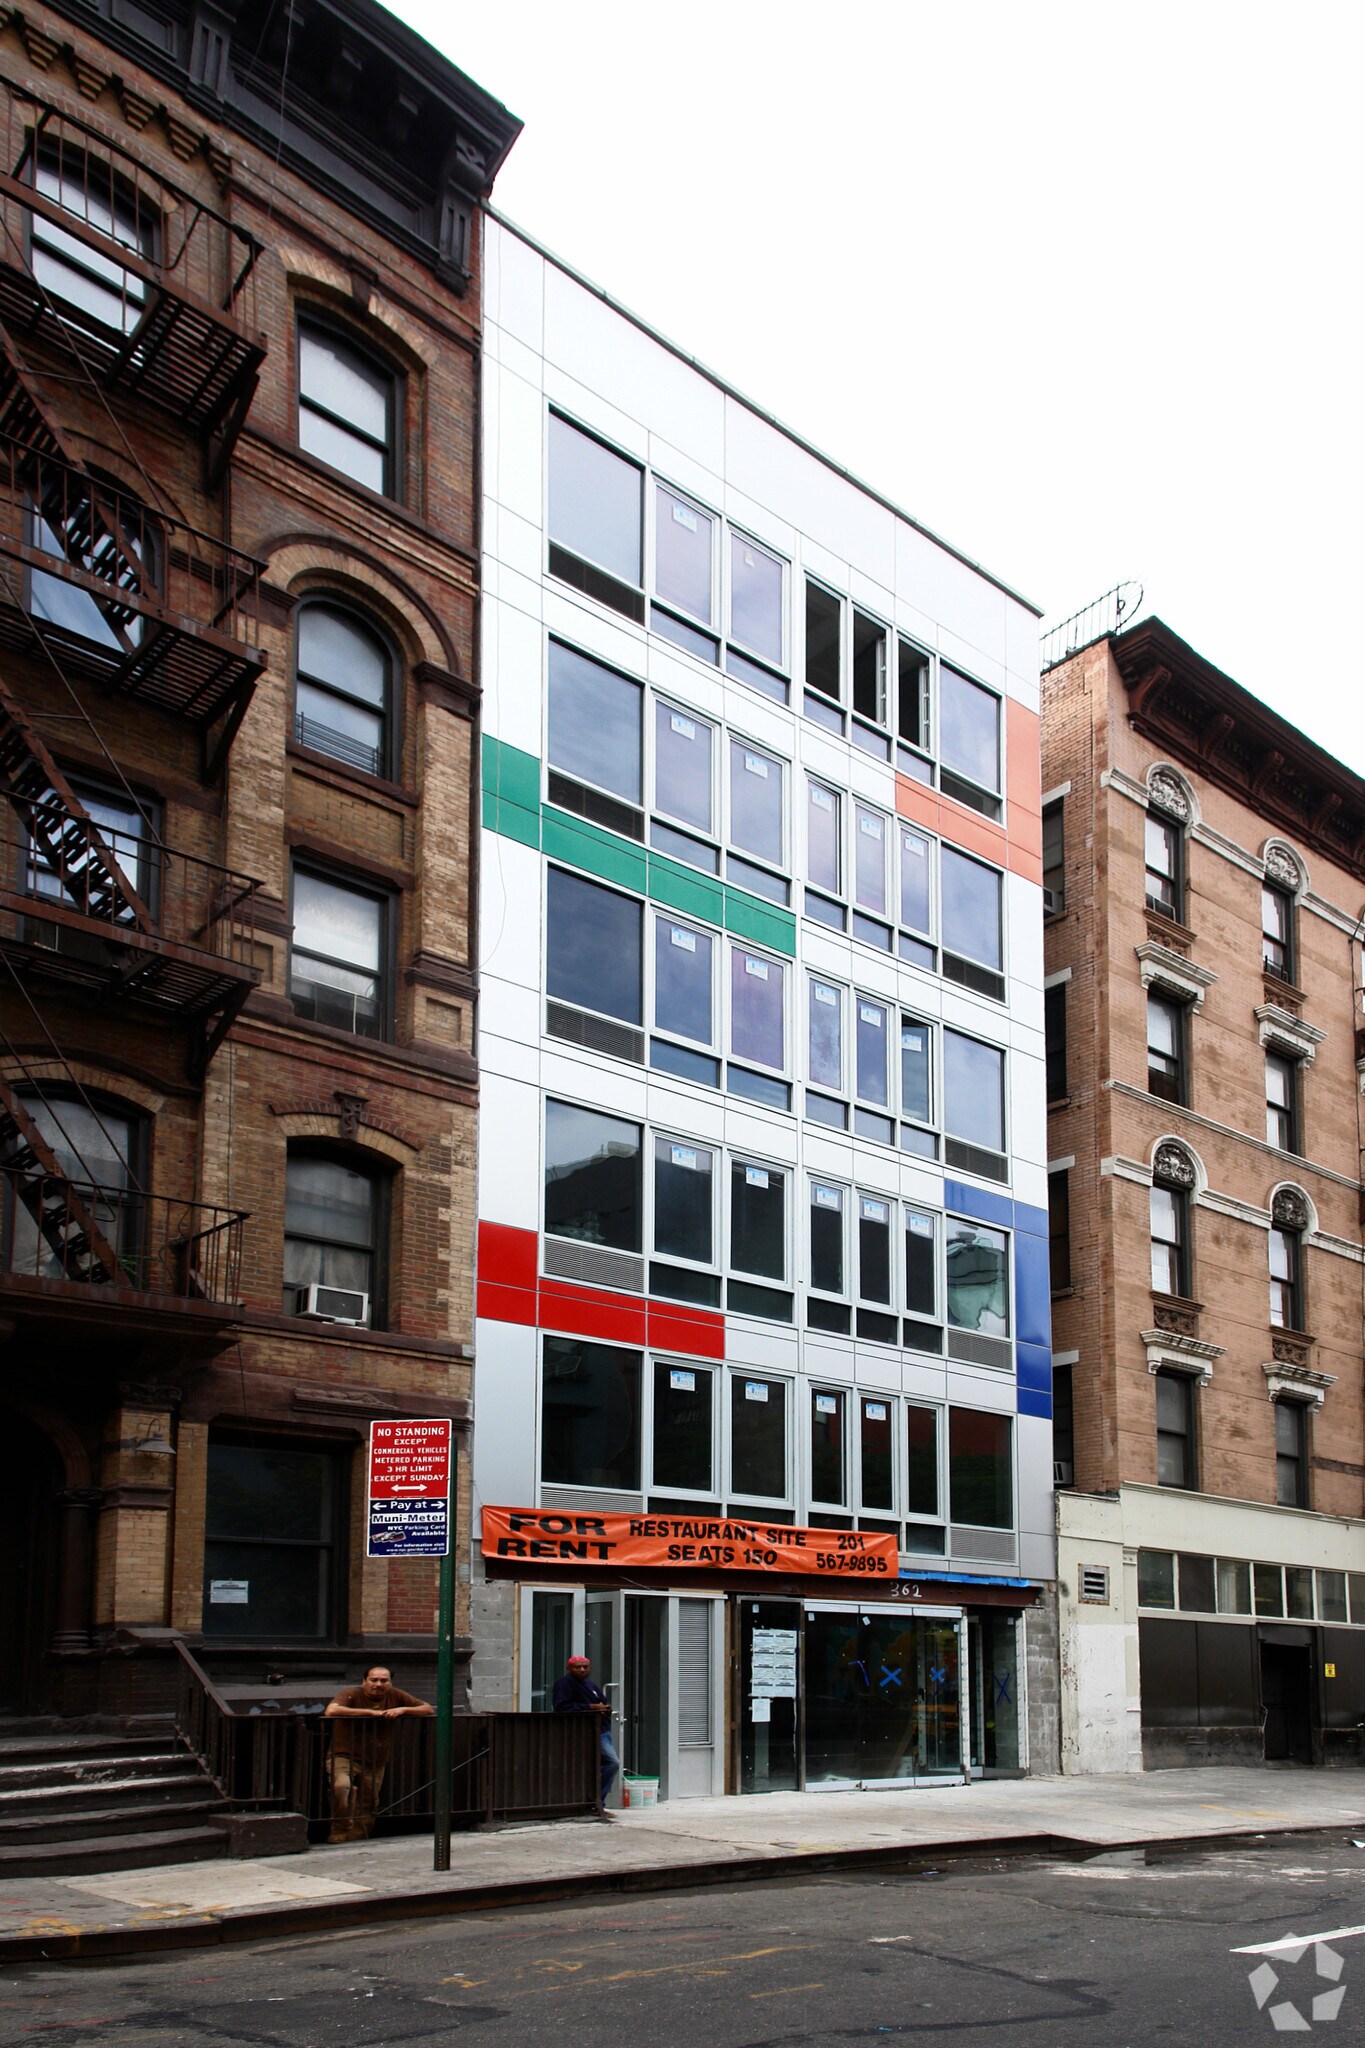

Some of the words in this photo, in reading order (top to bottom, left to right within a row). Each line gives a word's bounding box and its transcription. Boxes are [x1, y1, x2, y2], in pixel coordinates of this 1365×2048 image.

[378, 1428, 392, 1436] NO
[395, 1427, 445, 1436] STANDING
[390, 1501, 411, 1510] Pay
[373, 1514, 444, 1522] Muni-Meter
[510, 1514, 606, 1535] FOR
[630, 1520, 759, 1542] RESTAURANT
[766, 1529, 807, 1546] SITE
[498, 1538, 617, 1560] RENT
[838, 1535, 865, 1550] 201
[668, 1544, 734, 1563] SEATS
[743, 1548, 777, 1565] 150
[816, 1553, 887, 1572] 567-9895
[890, 1582, 922, 1598] 362
